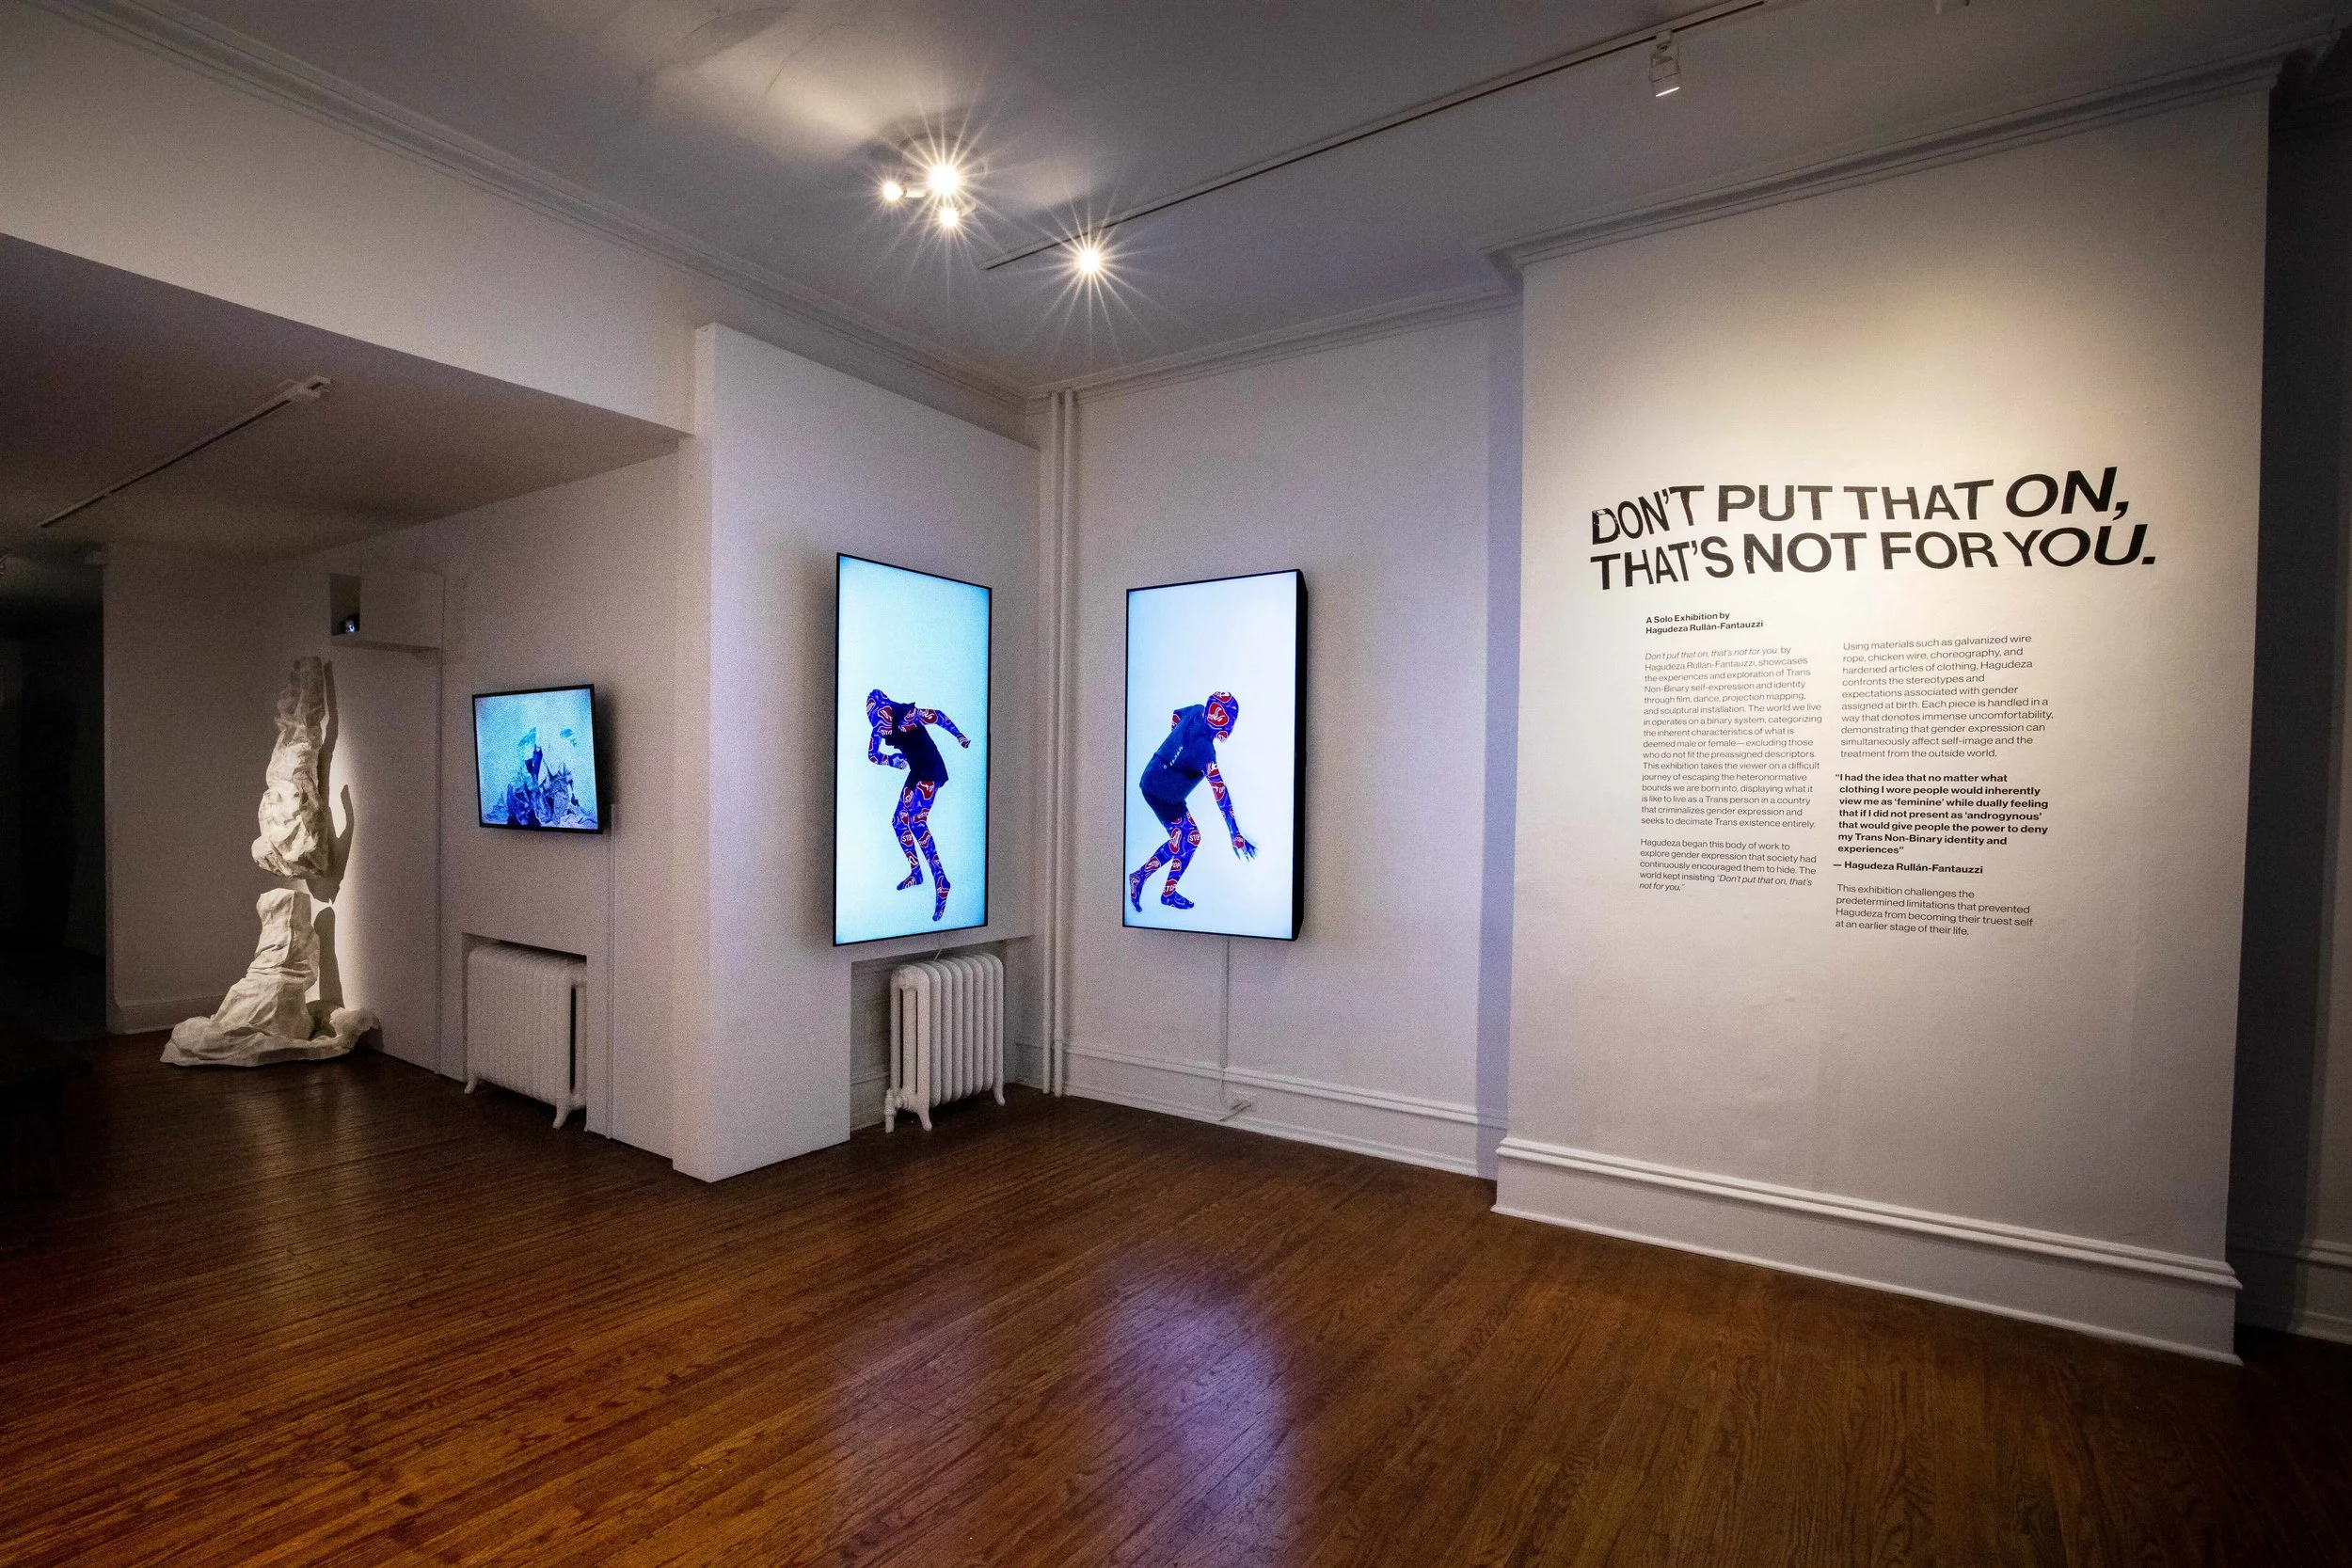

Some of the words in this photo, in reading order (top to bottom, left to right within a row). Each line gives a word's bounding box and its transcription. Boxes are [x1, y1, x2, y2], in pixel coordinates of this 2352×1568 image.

[1592, 484, 1705, 545] DON’T
[1718, 484, 1832, 522] PUT
[1844, 479, 1994, 520] THAT
[2005, 467, 2130, 522] ON,
[1591, 536, 1733, 590] THAT’S
[1745, 531, 1867, 574] NOT
[1882, 531, 1998, 570] FOR
[2004, 524, 2155, 566] YOU.
[1675, 612, 1718, 621] Exhibition
[1720, 611, 1729, 623] by
[1645, 626, 1688, 634] Hagudeza
[1690, 620, 1763, 630] Rullán-Fantauzzi
[1843, 642, 1869, 651] Using
[1871, 640, 1915, 649] materials
[1915, 639, 1939, 647] such
[1954, 635, 2008, 646] galvanized
[2010, 634, 2031, 642] wire
[1867, 653, 1904, 661] chicken
[1930, 649, 2001, 658] choreography,
[2003, 647, 2023, 656] and
[1842, 665, 1887, 673] hardened
[1889, 664, 1923, 673] articles
[1925, 662, 1934, 671] of
[1936, 662, 1978, 671] clothing,
[1980, 660, 2032, 670] Hagudeza
[1842, 677, 1887, 686] confronts
[1906, 675, 1963, 685] stereotypes
[1965, 673, 1984, 682] and
[1842, 689, 1902, 698] expectations
[1904, 688, 1957, 696] associated
[1981, 686, 2018, 696] gender
[1841, 702, 1883, 711] assigned
[1896, 700, 1919, 708] birth.
[1921, 700, 1947, 708] Each
[1948, 699, 1976, 708] piece
[1978, 698, 1986, 706] is
[1987, 698, 2028, 706] handled
[2030, 697, 2040, 705] in
[1969, 710, 2053, 720] uncomfortability,
[1840, 725, 1908, 735] demonstrating
[1911, 724, 1929, 733] that
[1931, 724, 1966, 734] gender
[1968, 723, 2024, 733] expression
[1840, 737, 1910, 746] simultaneously
[1912, 736, 1939, 745] affect
[1941, 736, 1993, 746] self-image
[1994, 736, 2014, 744] and
[2016, 736, 2033, 744] the
[1887, 749, 1909, 757] from
[1912, 749, 1927, 757] the
[1929, 749, 1964, 757] outside
[1980, 773, 2007, 782] what
[1839, 784, 1879, 794] clothing
[1913, 786, 1948, 795] people
[1985, 786, 2041, 796] inherently
[1946, 798, 1974, 806] while
[1976, 799, 2009, 808] dually
[2010, 799, 2048, 809] feeling
[1891, 821, 1913, 831] give
[1915, 823, 1950, 832] people
[2008, 824, 2018, 832] to
[2020, 825, 2048, 834] deny
[1641, 838, 1680, 847] Hagudeza
[1682, 839, 1708, 848] began
[1725, 841, 1747, 850] body
[1854, 832, 1883, 841] Trans
[1884, 833, 1942, 844] Non-Binary
[1945, 835, 1984, 845] identity
[1986, 836, 2007, 845] and
[1640, 849, 1670, 858] explore
[1671, 850, 1700, 859] gender
[1767, 854, 1798, 863] society
[1800, 854, 1817, 863] had
[1844, 861, 1894, 870] Hagudeza
[1896, 863, 1982, 873] Rullán-Fantauzzi
[1836, 883, 1856, 893] This
[1857, 885, 1902, 895] exhibition
[1904, 888, 1957, 898] challenges
[1959, 890, 1975, 898] the
[1836, 897, 1904, 907] predetermined
[1906, 899, 1955, 910] limitations
[1957, 901, 1976, 911] that
[1978, 904, 2029, 913] prevented
[1836, 908, 1883, 917] Hagudeza
[1884, 910, 1906, 918] from
[1908, 911, 1956, 923] becoming
[1958, 914, 1980, 923] their
[1982, 916, 2011, 925] truest
[1858, 921, 1888, 929] earlier
[1889, 923, 1916, 933] stage
[1917, 924, 1928, 932] of
[1930, 925, 1951, 933] their
[1953, 926, 1969, 935] life.
